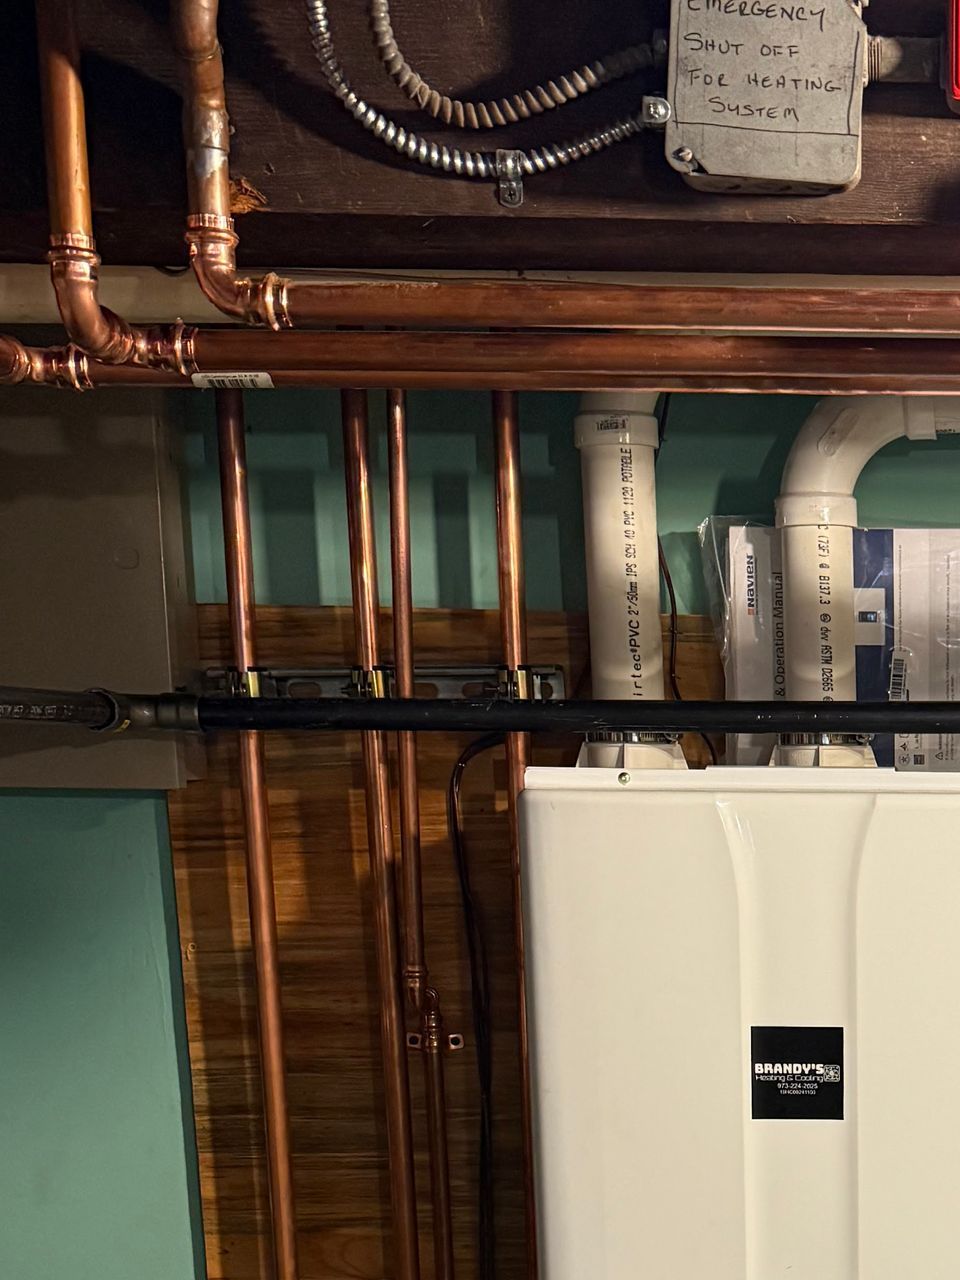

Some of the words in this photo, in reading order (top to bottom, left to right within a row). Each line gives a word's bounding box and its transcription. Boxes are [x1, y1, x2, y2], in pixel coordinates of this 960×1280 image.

[687, 0, 826, 32] EMERGENCY
[684, 33, 744, 56] SHUT
[760, 44, 800, 58] OFF
[688, 68, 729, 87] FOR
[747, 73, 842, 92] HEATING
[708, 96, 799, 122] SYSTEM
[620, 447, 633, 483] POTABLE
[622, 487, 634, 505] 1120
[626, 563, 637, 577] IPS
[772, 571, 784, 618] Manual
[819, 575, 831, 605] B137.3
[773, 622, 785, 685] Operation
[821, 645, 832, 665] ASTM
[775, 687, 785, 697] &
[822, 668, 833, 692] D2665
[754, 1063, 825, 1074] BRANDY'S
[755, 1074, 786, 1082] Heating
[795, 1075, 824, 1083] Cooling
